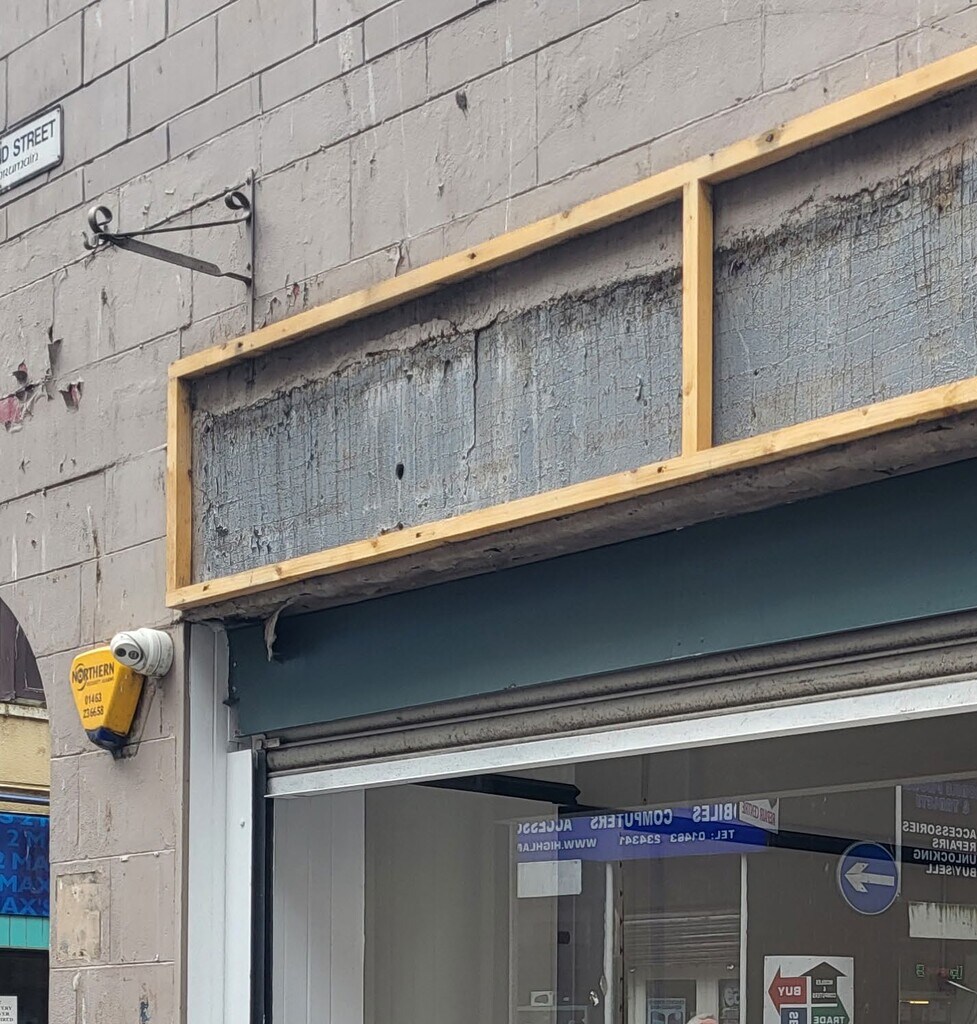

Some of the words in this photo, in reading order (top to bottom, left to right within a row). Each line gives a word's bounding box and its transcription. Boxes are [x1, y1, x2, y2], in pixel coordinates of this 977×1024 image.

[13, 118, 56, 157] STREET
[72, 662, 114, 684] NORTHERN
[84, 692, 102, 706] 01463
